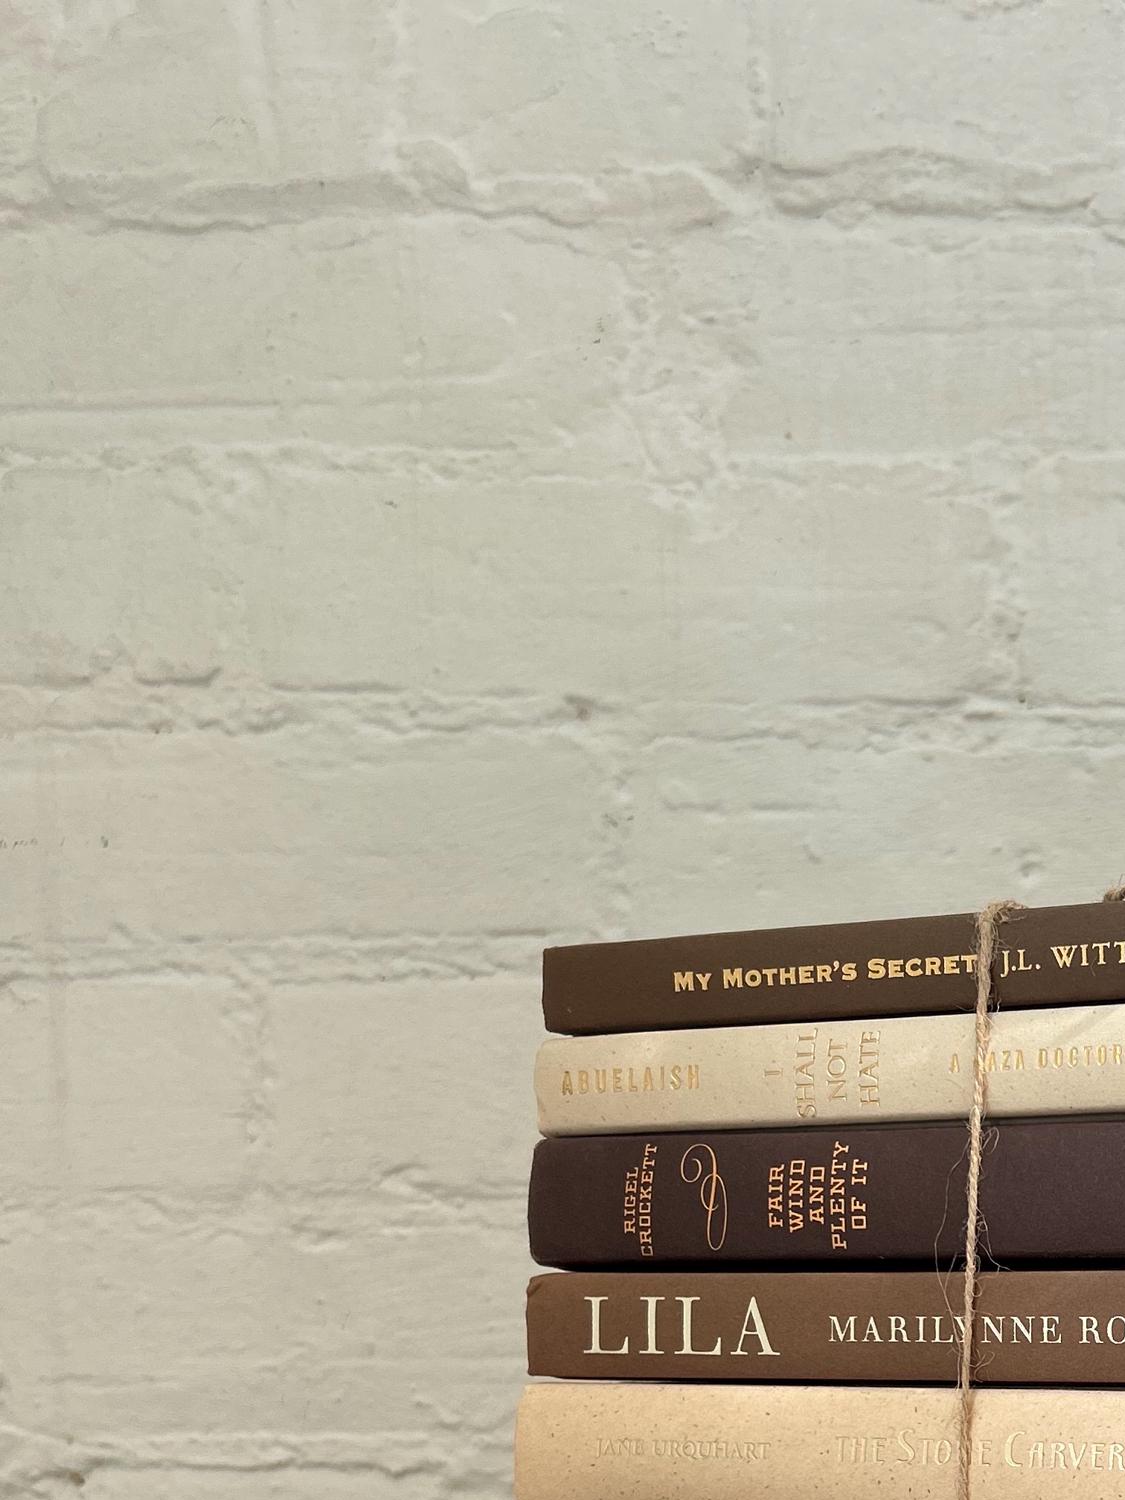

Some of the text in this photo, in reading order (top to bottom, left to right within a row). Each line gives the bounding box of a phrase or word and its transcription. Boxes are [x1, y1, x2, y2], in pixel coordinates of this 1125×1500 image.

[673, 953, 978, 992] MY MOTHER'S SECRET
[1000, 949, 1041, 978] J.L.
[561, 1062, 700, 1097] ABUELAISH
[796, 1027, 819, 1119] SHALL
[824, 1037, 849, 1101] NOT
[858, 1030, 881, 1107] HATE
[949, 1053, 960, 1073] A
[973, 1049, 1025, 1073] AZA
[624, 1166, 639, 1234] RIGEL
[640, 1143, 658, 1257] CROCKETT
[768, 1164, 784, 1228] FAIR
[789, 1159, 806, 1233] WIND
[810, 1165, 826, 1224] AND
[831, 1140, 850, 1250] PLENTY
[851, 1158, 867, 1230] OF IT
[583, 1296, 781, 1356] LILA
[828, 1315, 1062, 1344] MARILYNNE
[596, 1437, 772, 1462] JANE URQUHART
[835, 1435, 885, 1465] THE
[896, 1428, 993, 1468] STOE
